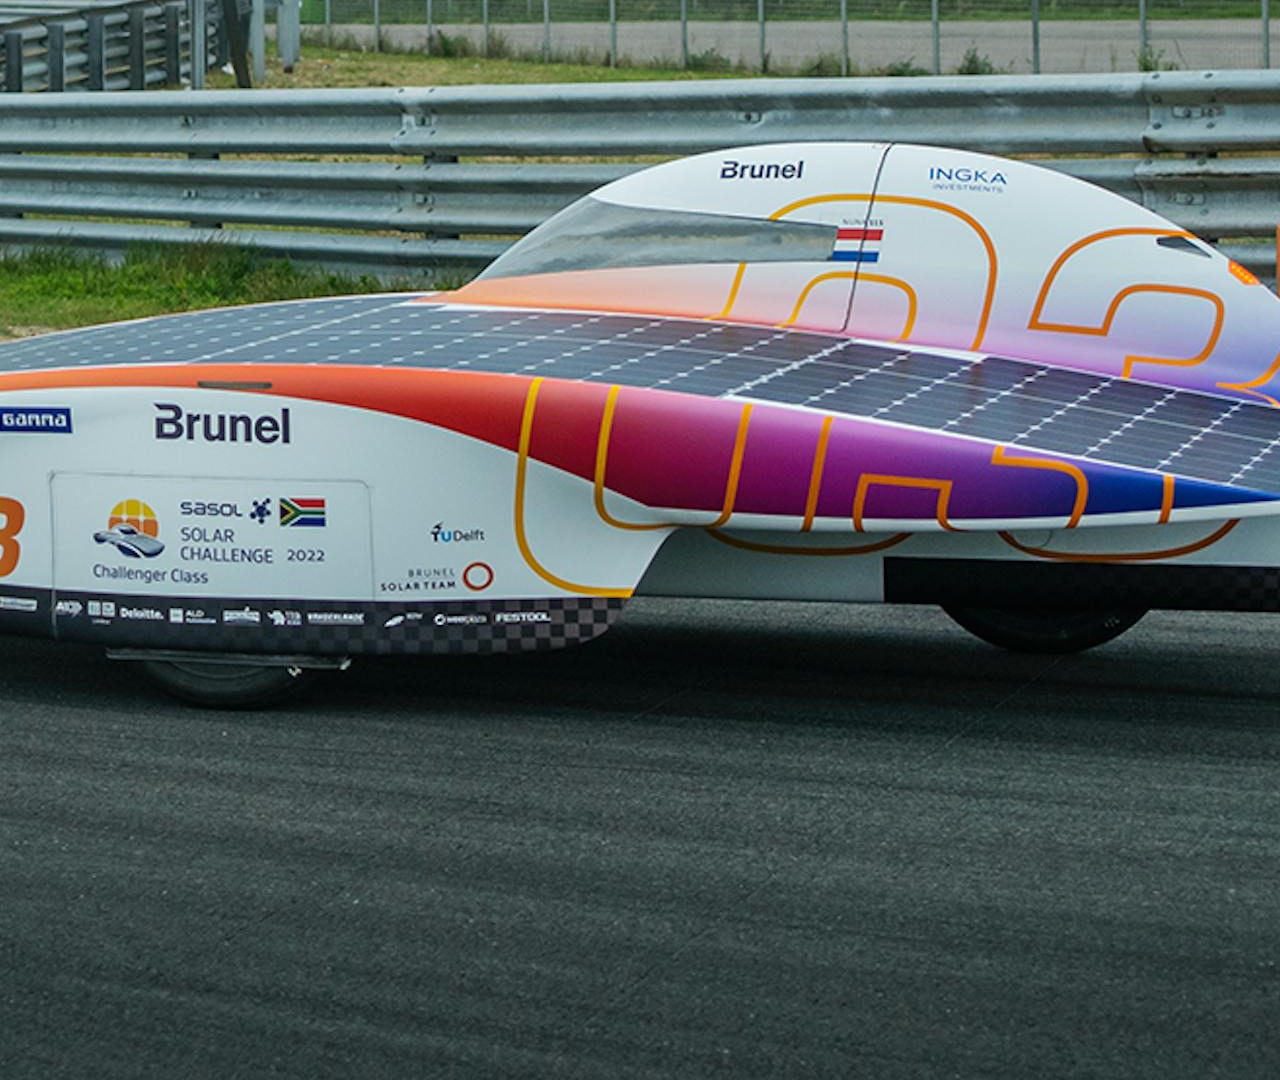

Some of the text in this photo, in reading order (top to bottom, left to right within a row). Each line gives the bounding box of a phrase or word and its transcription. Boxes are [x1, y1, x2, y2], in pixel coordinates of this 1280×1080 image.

[720, 160, 804, 179] Brunel
[930, 168, 1007, 184] INGKA
[932, 184, 1004, 193] INVESTMENTS
[154, 402, 291, 444] Brunel
[180, 526, 235, 543] SOLAR
[180, 546, 325, 564] CHALLENGE 2022
[92, 563, 209, 584] Challenger Class
[407, 568, 456, 578] BRUNEL
[381, 580, 456, 592] SOLAR TEAM
